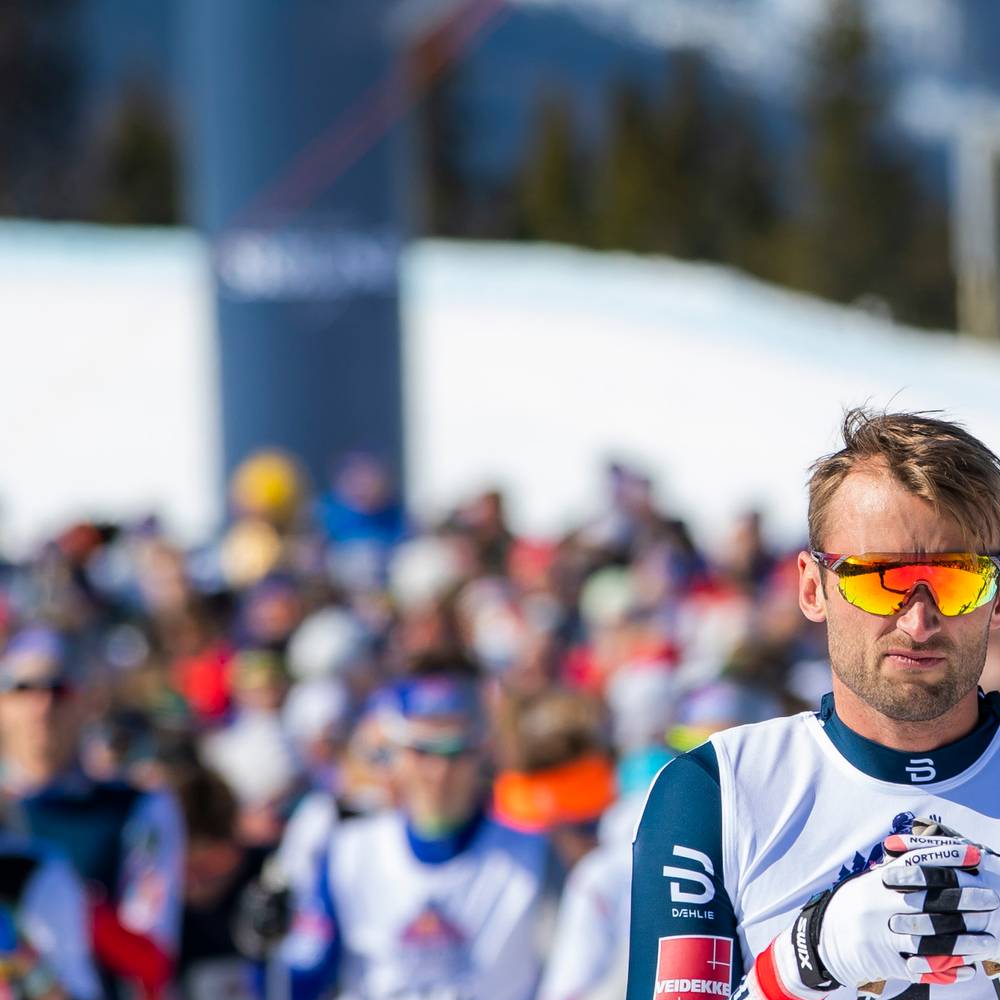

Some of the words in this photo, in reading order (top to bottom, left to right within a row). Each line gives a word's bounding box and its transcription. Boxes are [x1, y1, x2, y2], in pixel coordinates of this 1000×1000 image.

[905, 850, 960, 867] NORTHUG
[671, 908, 715, 920] DÆHLIE
[656, 979, 731, 997] VEIDEKKE
